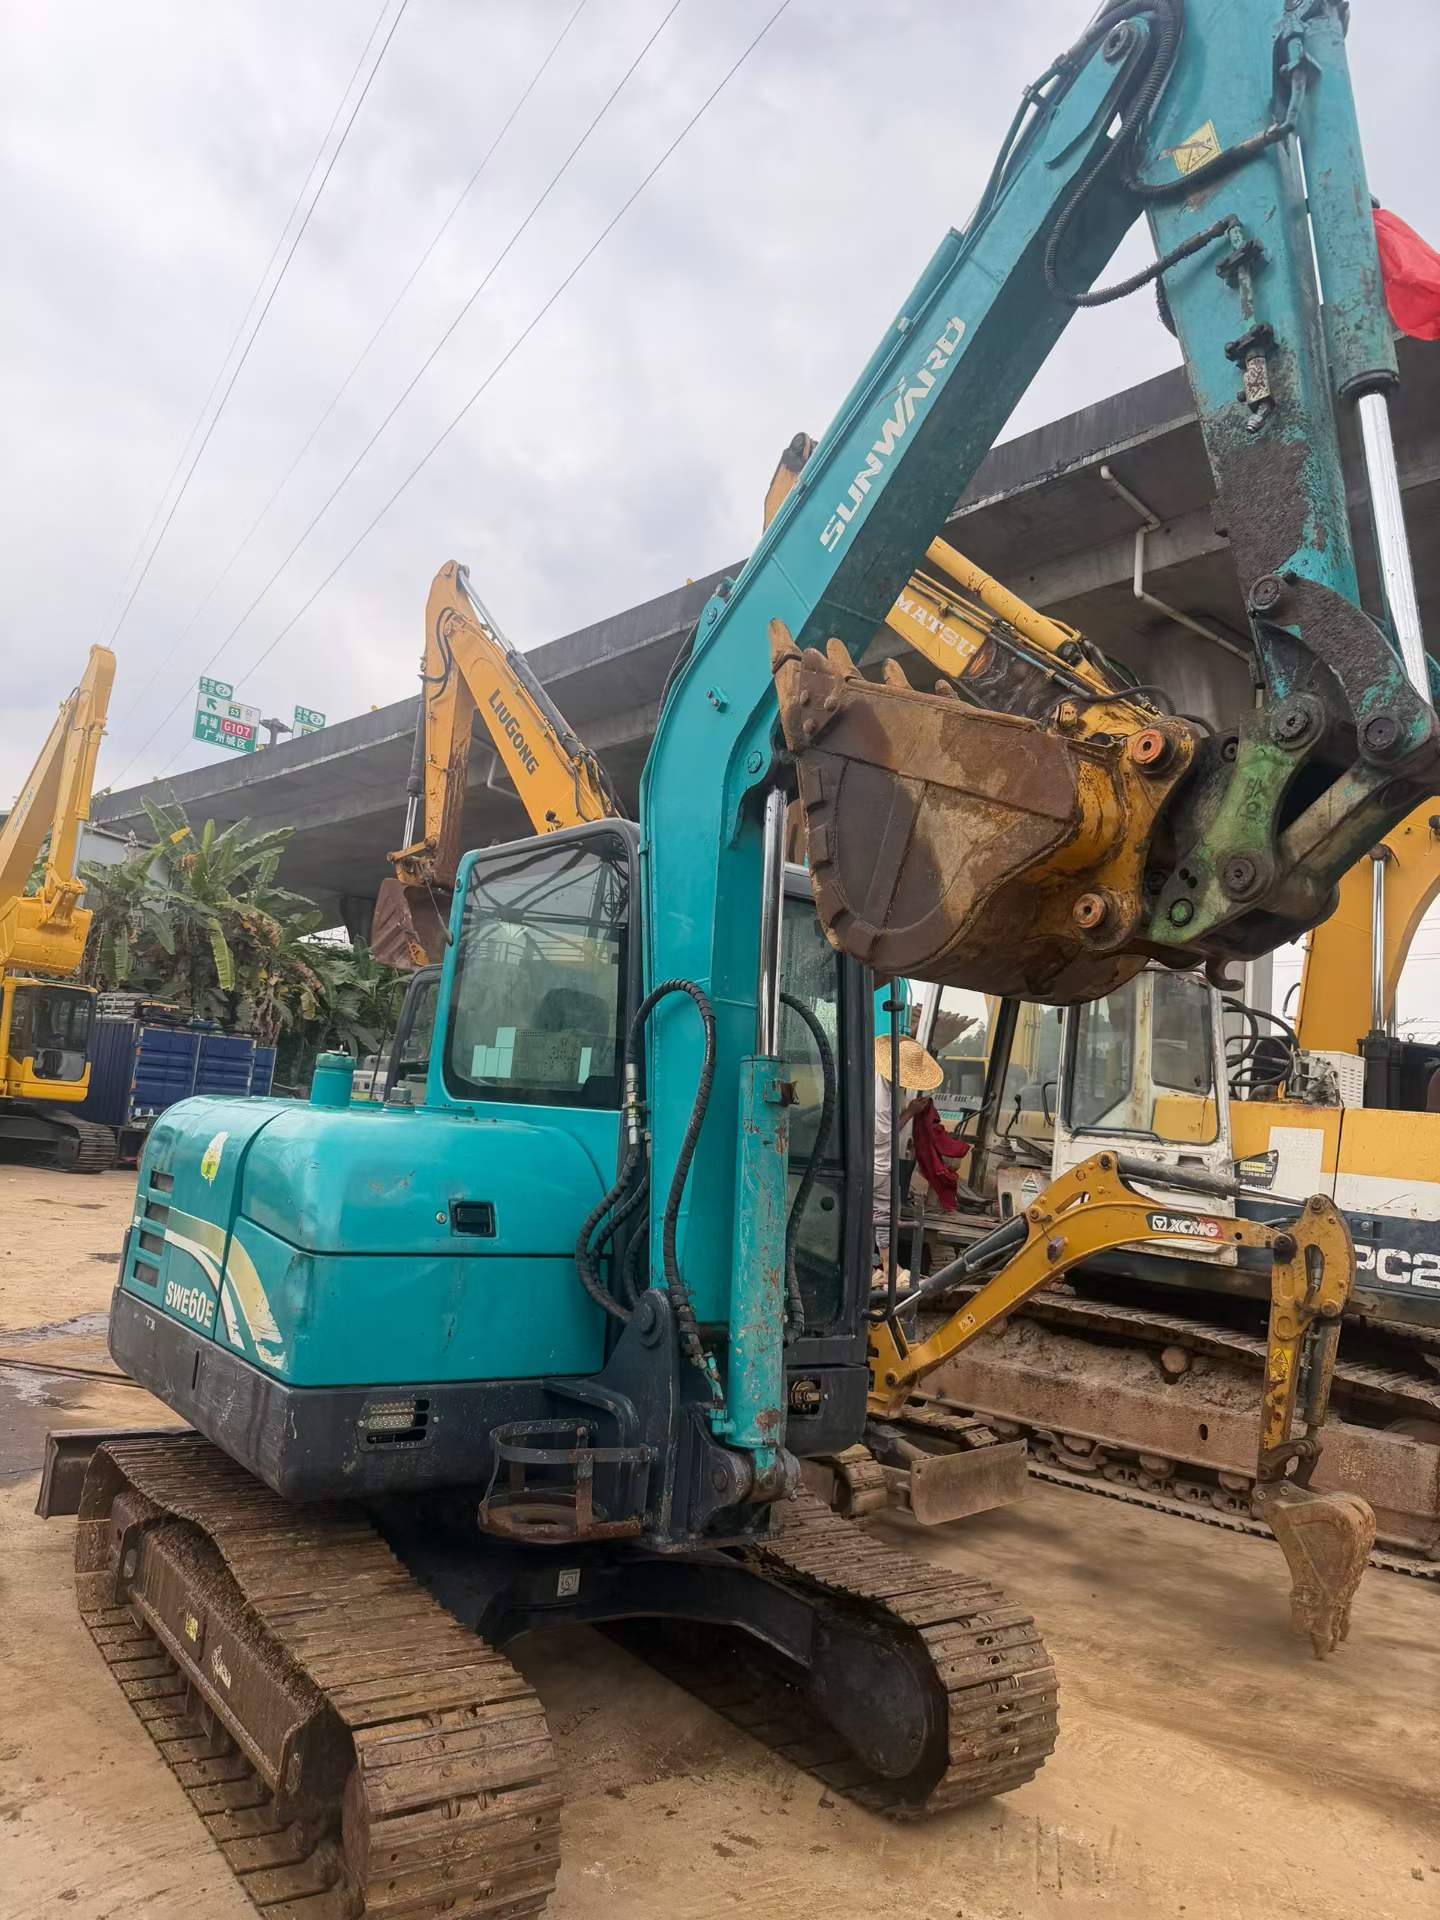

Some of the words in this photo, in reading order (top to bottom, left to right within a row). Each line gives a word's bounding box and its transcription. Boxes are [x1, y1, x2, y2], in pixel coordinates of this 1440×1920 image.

[819, 316, 966, 553] SUNWARD
[203, 729, 246, 749] 广州城区
[224, 721, 251, 737] G107
[487, 687, 540, 776] LIUGONG
[1167, 1218, 1219, 1237] XCMG
[1353, 1243, 1440, 1290] PC2
[165, 1280, 214, 1328] SWE60E
